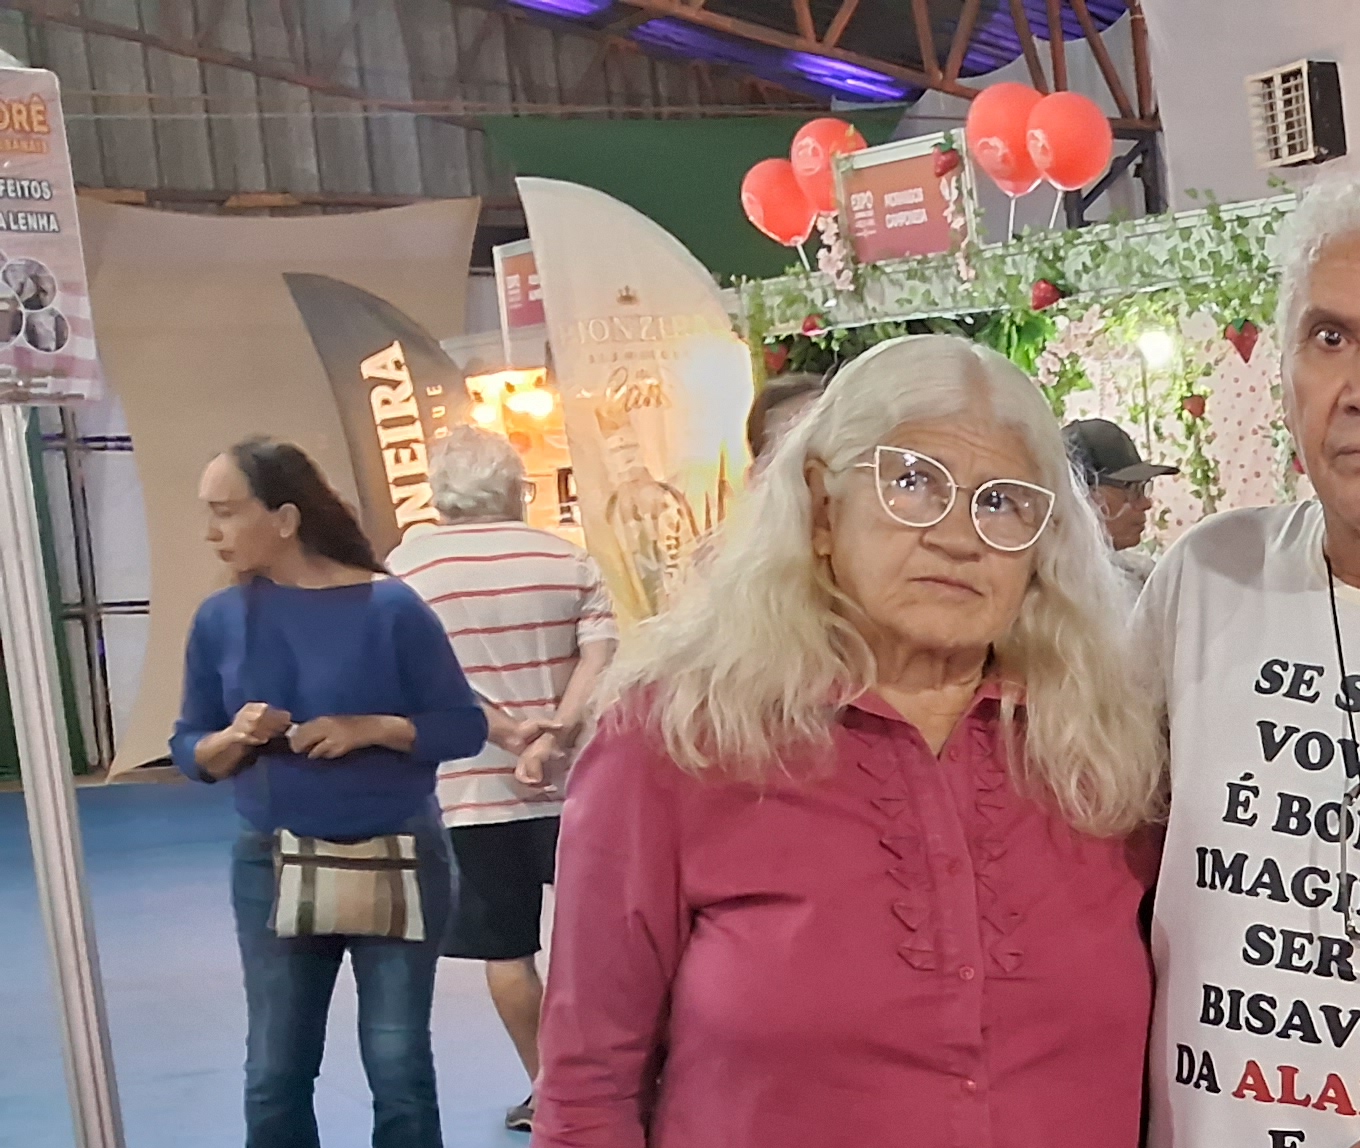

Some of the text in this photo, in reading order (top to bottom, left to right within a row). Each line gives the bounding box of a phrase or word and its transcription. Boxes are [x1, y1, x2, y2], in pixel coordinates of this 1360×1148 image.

[1253, 658, 1325, 704] SE
[1222, 771, 1260, 827] É
[1241, 923, 1357, 982] SER
[1175, 1042, 1222, 1095] DA
